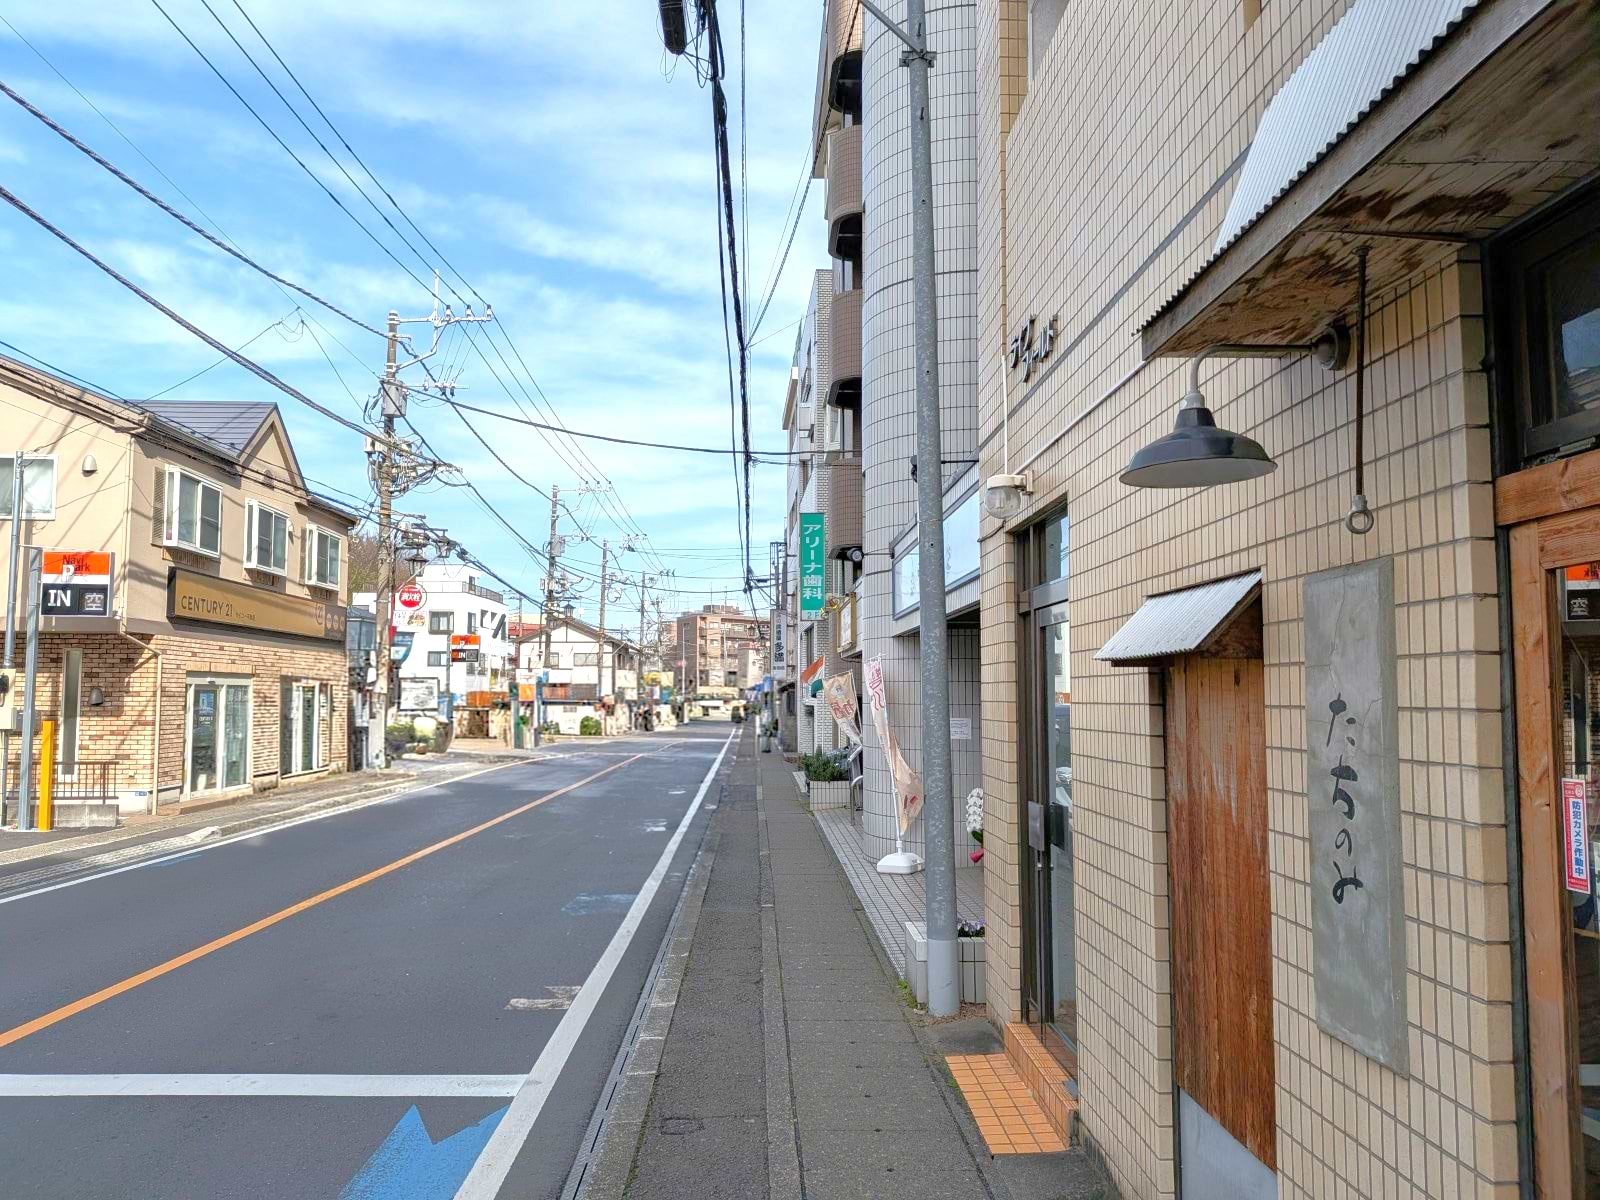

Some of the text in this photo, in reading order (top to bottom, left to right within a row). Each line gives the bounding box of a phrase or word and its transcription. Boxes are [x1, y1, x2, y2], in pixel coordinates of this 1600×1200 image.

[63, 553, 85, 565] Navi
[803, 524, 823, 600] アリーナ歯科
[48, 589, 71, 607] IN
[84, 592, 105, 612] 空
[181, 595, 234, 618] CENTURY 21
[1327, 692, 1364, 904] たちのみ
[1572, 800, 1585, 877] 防犯カメラ作動中
